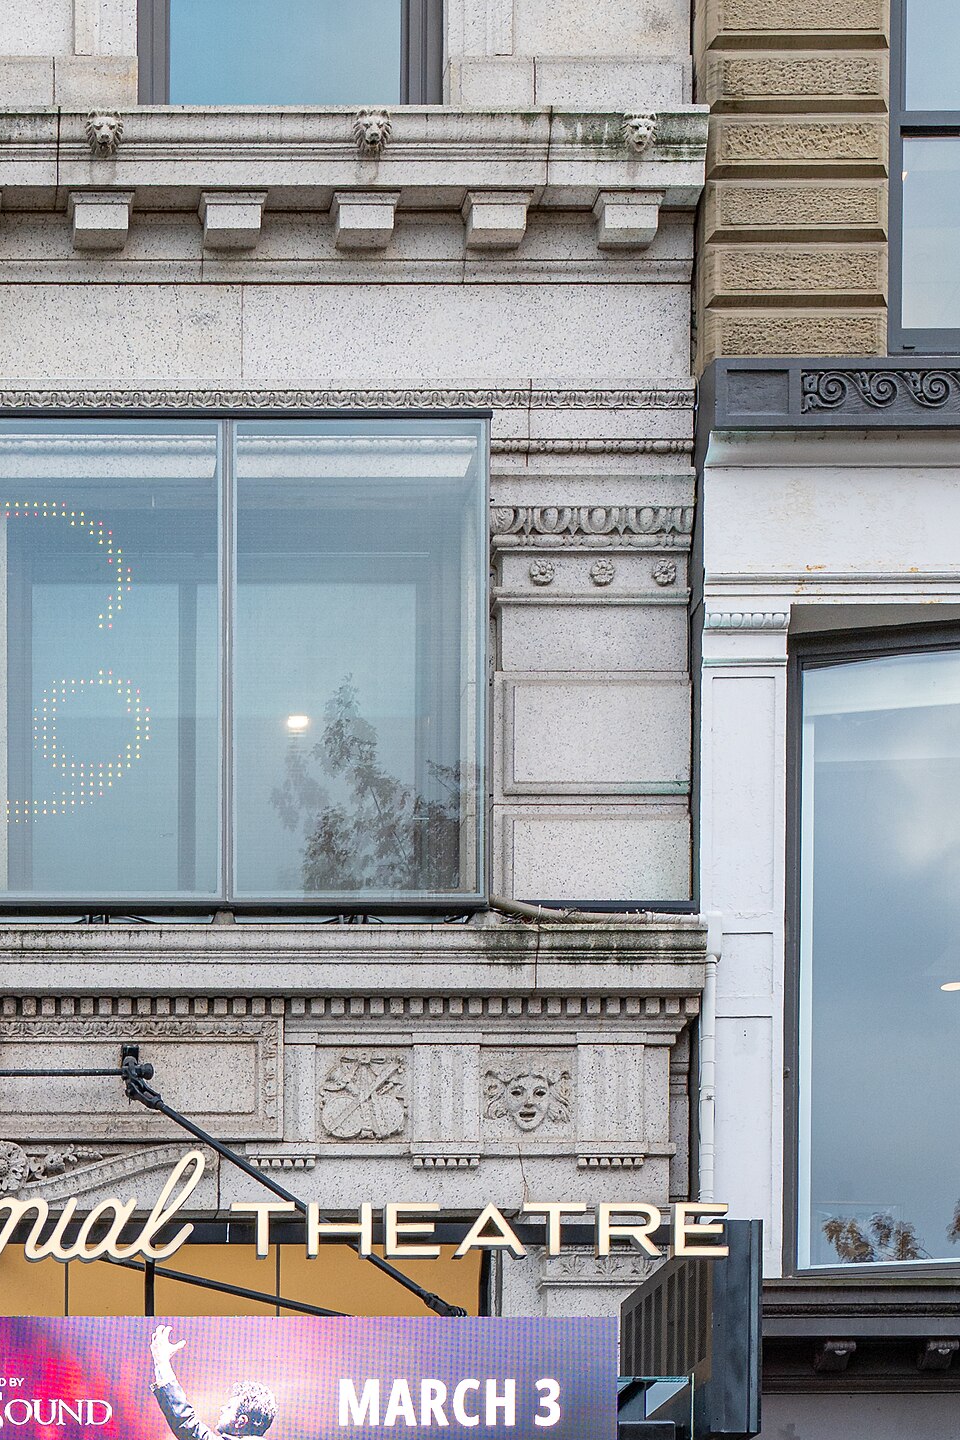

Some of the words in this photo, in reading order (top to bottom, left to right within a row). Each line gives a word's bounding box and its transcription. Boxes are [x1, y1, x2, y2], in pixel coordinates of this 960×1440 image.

[230, 1201, 731, 1261] THEATRE
[9, 1377, 25, 1387] BY
[337, 1378, 517, 1428] MARCH
[533, 1378, 562, 1428] 3
